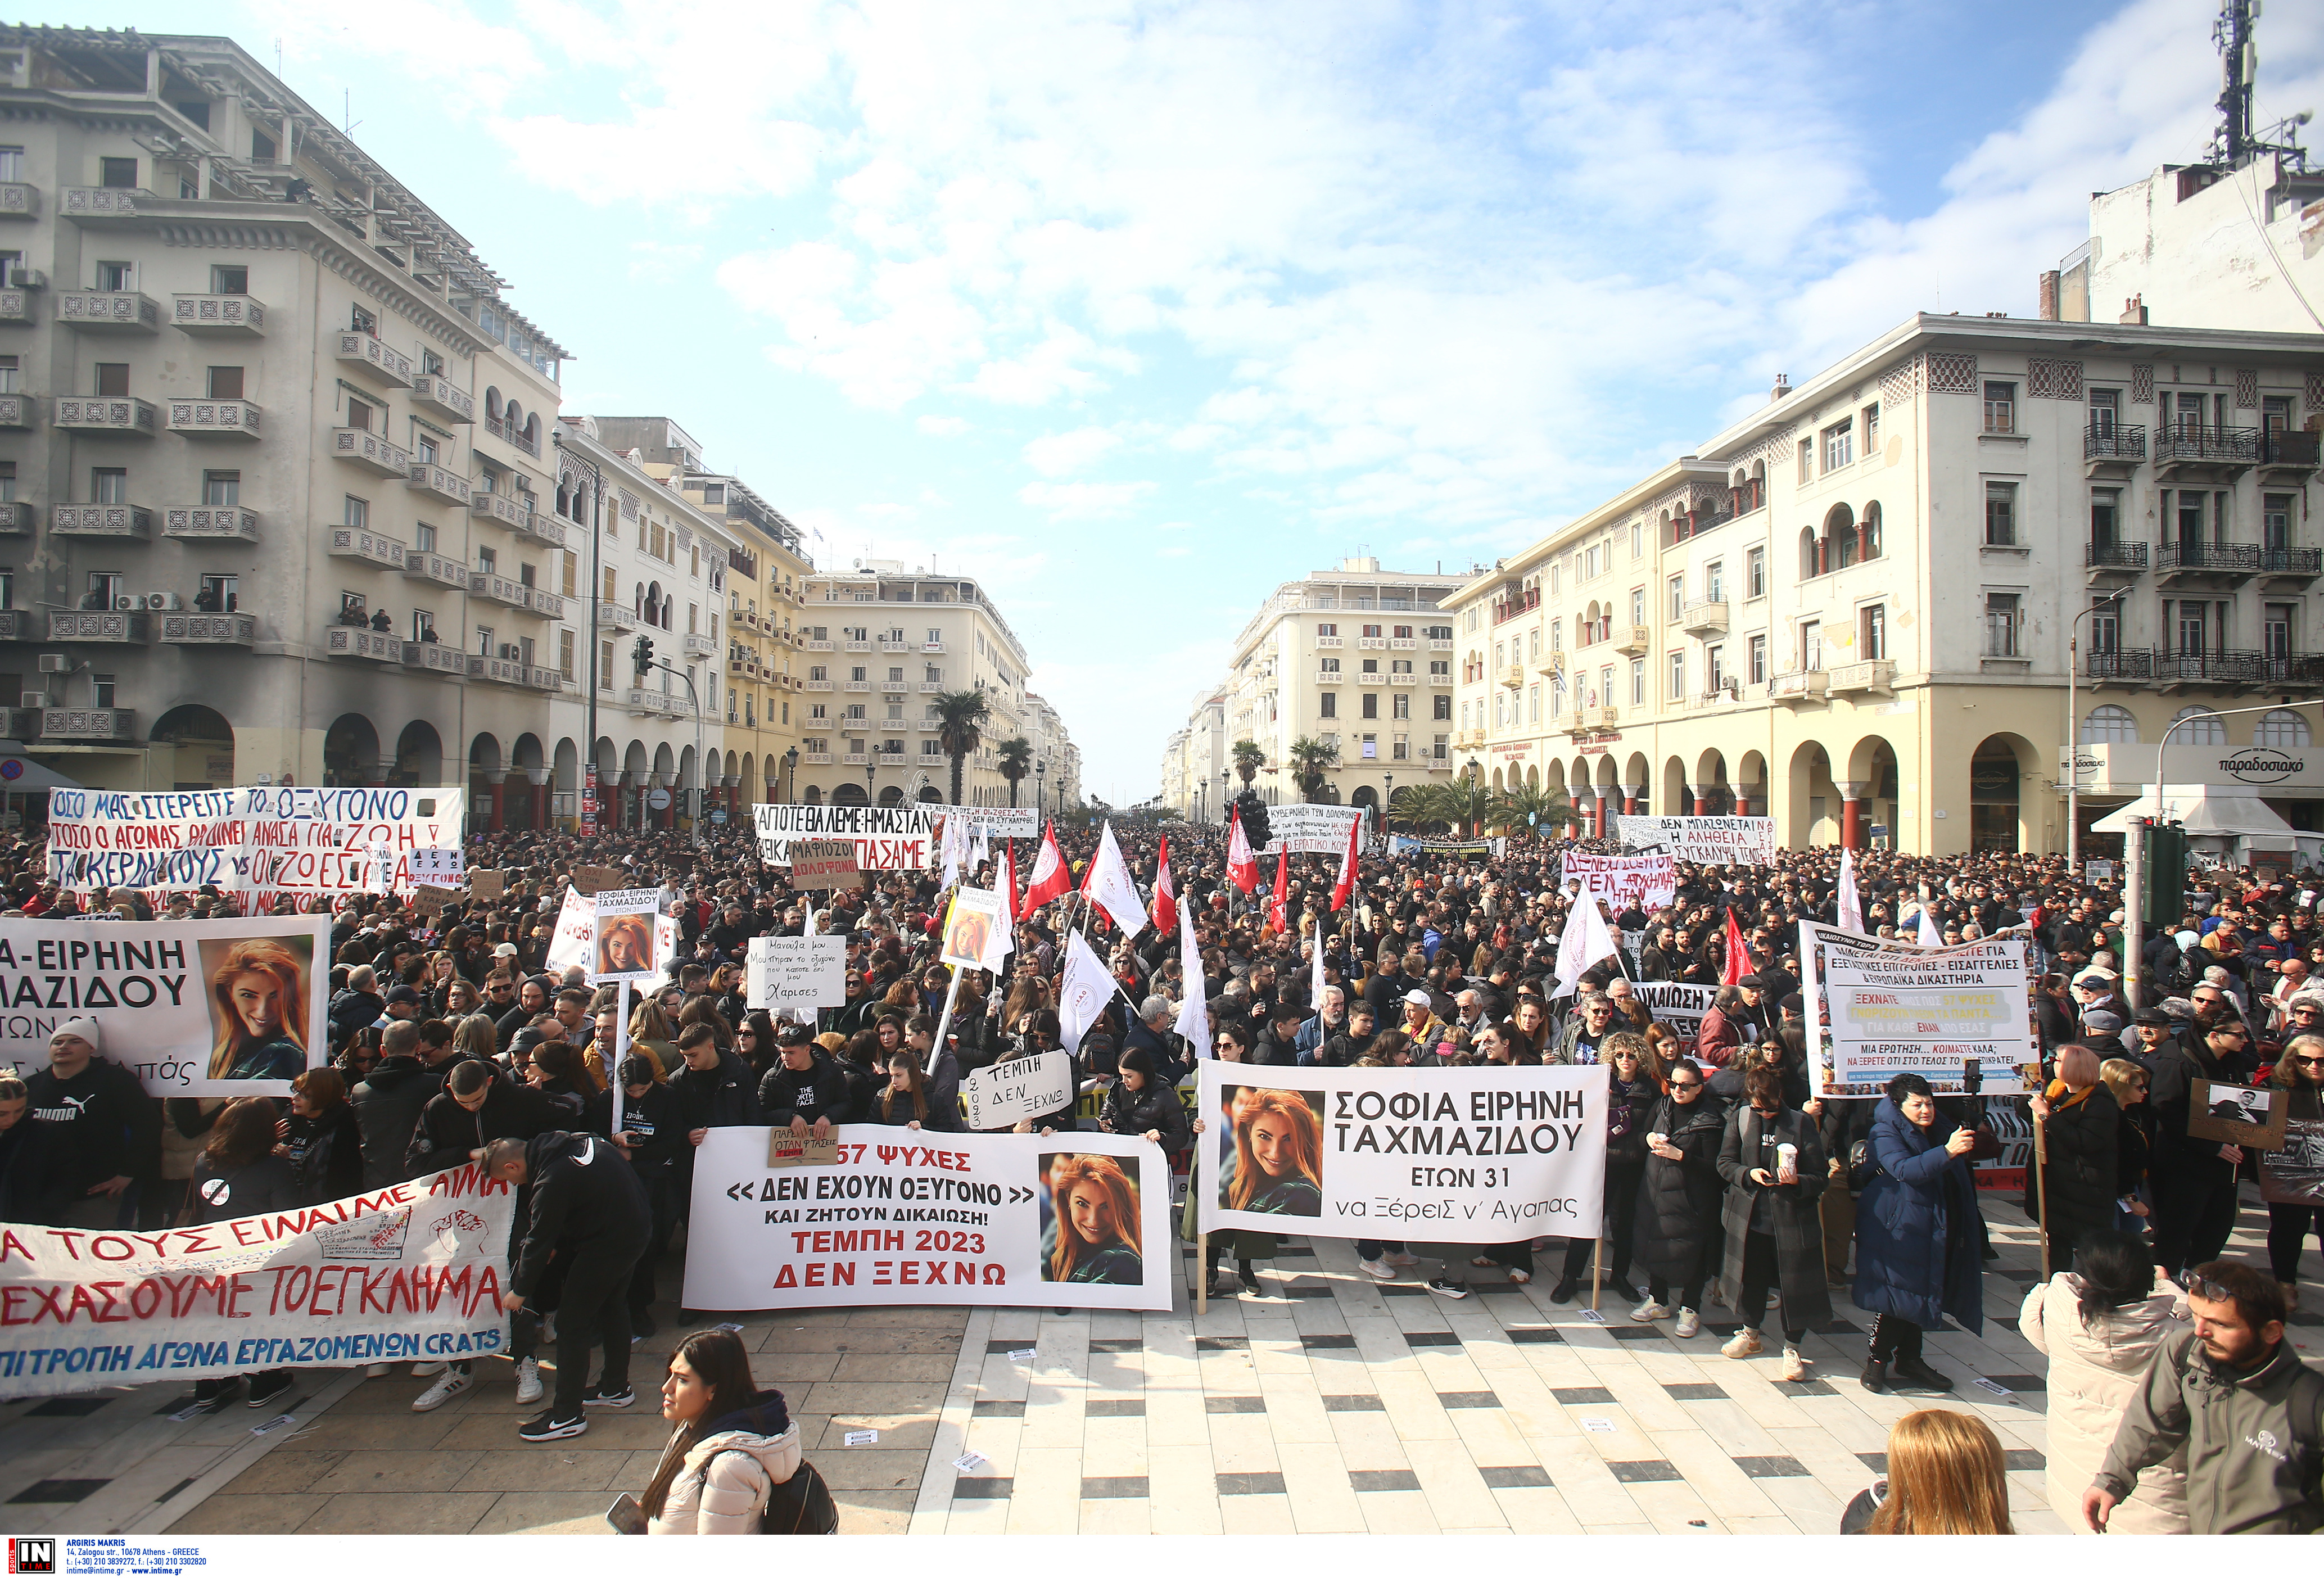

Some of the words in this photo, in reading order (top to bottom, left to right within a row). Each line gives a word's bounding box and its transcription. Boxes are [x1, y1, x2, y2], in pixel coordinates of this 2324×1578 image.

[2219, 757, 2303, 774] παραδοσιακό
[55, 791, 85, 818] ΟΣΟ
[93, 794, 135, 820] ΜΑΣ
[141, 792, 235, 819] ΣΤΕΡΕΙΤΕ
[247, 788, 266, 813] ΤΟ
[278, 789, 408, 821] ΟΞΥΓΟΝΟ
[1271, 807, 1309, 819] ΚΥΒΕΡΝΗΣΗ
[1661, 819, 1682, 829] ΔΕΝ
[1688, 819, 1755, 831] ΜΠΑΖΩΝΕΤΑΙ
[52, 823, 91, 848] ΤΟΣΟ
[116, 825, 182, 849] ΑΓΩΝΑΣ
[252, 821, 297, 847] ΑΝΑΣΑ
[308, 823, 332, 847] ΓΙΑ
[1688, 831, 1747, 845] ΑΛΗΘΕΙΑ
[414, 851, 458, 860] ΔΕΝ
[792, 842, 854, 858] ΜΑΦΙΟΖΟΙ
[417, 860, 458, 869] ΕΧΩ
[585, 869, 602, 877] ΟΧΙ
[599, 889, 658, 899] ΣΟΦΙΑ-ΕΙΡΗΝΗ
[960, 894, 999, 907] ΤΑΧΜΑΖΙΔΟΥ
[598, 896, 657, 908] ΤΑΧΜΑΖΙΔΟΥ
[770, 940, 806, 952] Μανούλα
[1817, 932, 1856, 945] ΔΙΚΑΙΟΣΥΝΗ
[1856, 941, 1875, 950] ΤΩΡΑ
[1986, 946, 2006, 956] ΓΙΑ
[750, 952, 766, 965] Μου
[768, 954, 793, 965] πήραν
[811, 954, 836, 967] οξυγόνο
[1832, 958, 1882, 971] ΕΞΕΤΑΣΤΙΚΕΣ
[1948, 960, 2019, 971] ΕΙΣΑΓΓΕΛΙΕΣ
[1918, 974, 1984, 985] ΔΙΚΑΣΤΗΡΙΑ
[1856, 994, 1899, 1005] ΞΕΧΝΑΤΕ
[1943, 996, 1956, 1005] 57
[1959, 994, 1996, 1005] ΨΥΧΕΣ
[1851, 1008, 1910, 1019] ΓΝΩΡΙΖΟΥΝ
[1937, 1009, 1949, 1019] ΤΑ
[1868, 1022, 1884, 1033] ΓΙΑ
[1887, 1022, 1915, 1033] ΚΑΘΕ
[1918, 1023, 1940, 1033] ΕΝΑΝ
[1960, 1023, 1986, 1033] ΕΣΑΣ
[1861, 1045, 1877, 1053] ΜΙΑ
[1879, 1045, 1929, 1053] ΕΡΩΤΗΣΗ...
[1933, 1045, 1972, 1053] ΚΟΙΜΑΣΤΕ
[1973, 1045, 1997, 1055] ΚΑΛΑ;
[1847, 1057, 1857, 1066] ΝΑ
[1859, 1057, 1885, 1065] ΞΕΡΕΤΕ
[1887, 1057, 1900, 1065] ΟΤΙ
[1902, 1057, 1919, 1065] ΣΤΟ
[1921, 1057, 1947, 1065] ΤΕΛΟΣ
[987, 1056, 1042, 1082] ΤΕΜΠΗ
[799, 1086, 813, 1094] THE
[992, 1083, 1026, 1105] ΔΕΝ
[1023, 1089, 1063, 1113] ΞΕΧΝΩ
[1335, 1091, 1459, 1122] ΣΟΦΙΑ
[1471, 1089, 1584, 1120] ΕΙΡΗΝΗ
[775, 1140, 801, 1150] ΟΤΑΝ
[803, 1138, 837, 1148] ΦΤΑΣΕΙΣ
[1335, 1124, 1583, 1155] ΤΑΧΜΑΖΙΔΟΥ
[837, 1143, 866, 1165] 57
[876, 1145, 971, 1172] ΨΥΧΕΣ
[1412, 1167, 1475, 1187] ΕΤΩΝ
[1485, 1167, 1509, 1187] 31
[760, 1177, 808, 1202] ΔΕΝ
[816, 1175, 893, 1201] ΕΧΟΥΝ
[899, 1177, 1002, 1206] ΟΞΥΓΟΝΟ
[1336, 1201, 1366, 1217] να
[765, 1208, 798, 1224] ΚΑΙ
[805, 1206, 887, 1223] ΖΗΤΟΥΝ
[892, 1208, 989, 1227] ΔΙΚΑΙΩΣΗ!
[47, 1227, 222, 1260] ΤΟΥΣ
[790, 1229, 905, 1254] ΤΕΜΠΗ
[915, 1230, 985, 1254] 2023
[773, 1262, 856, 1289] ΔΕΝ
[872, 1261, 1006, 1286] ΞΕΧΝΩ
[135, 1341, 229, 1369] ΑΓΩΝΑ
[235, 1333, 420, 1364] ΕΡΓΑΖΟΜΕΝΩΝ
[422, 1329, 501, 1353] CRATS
